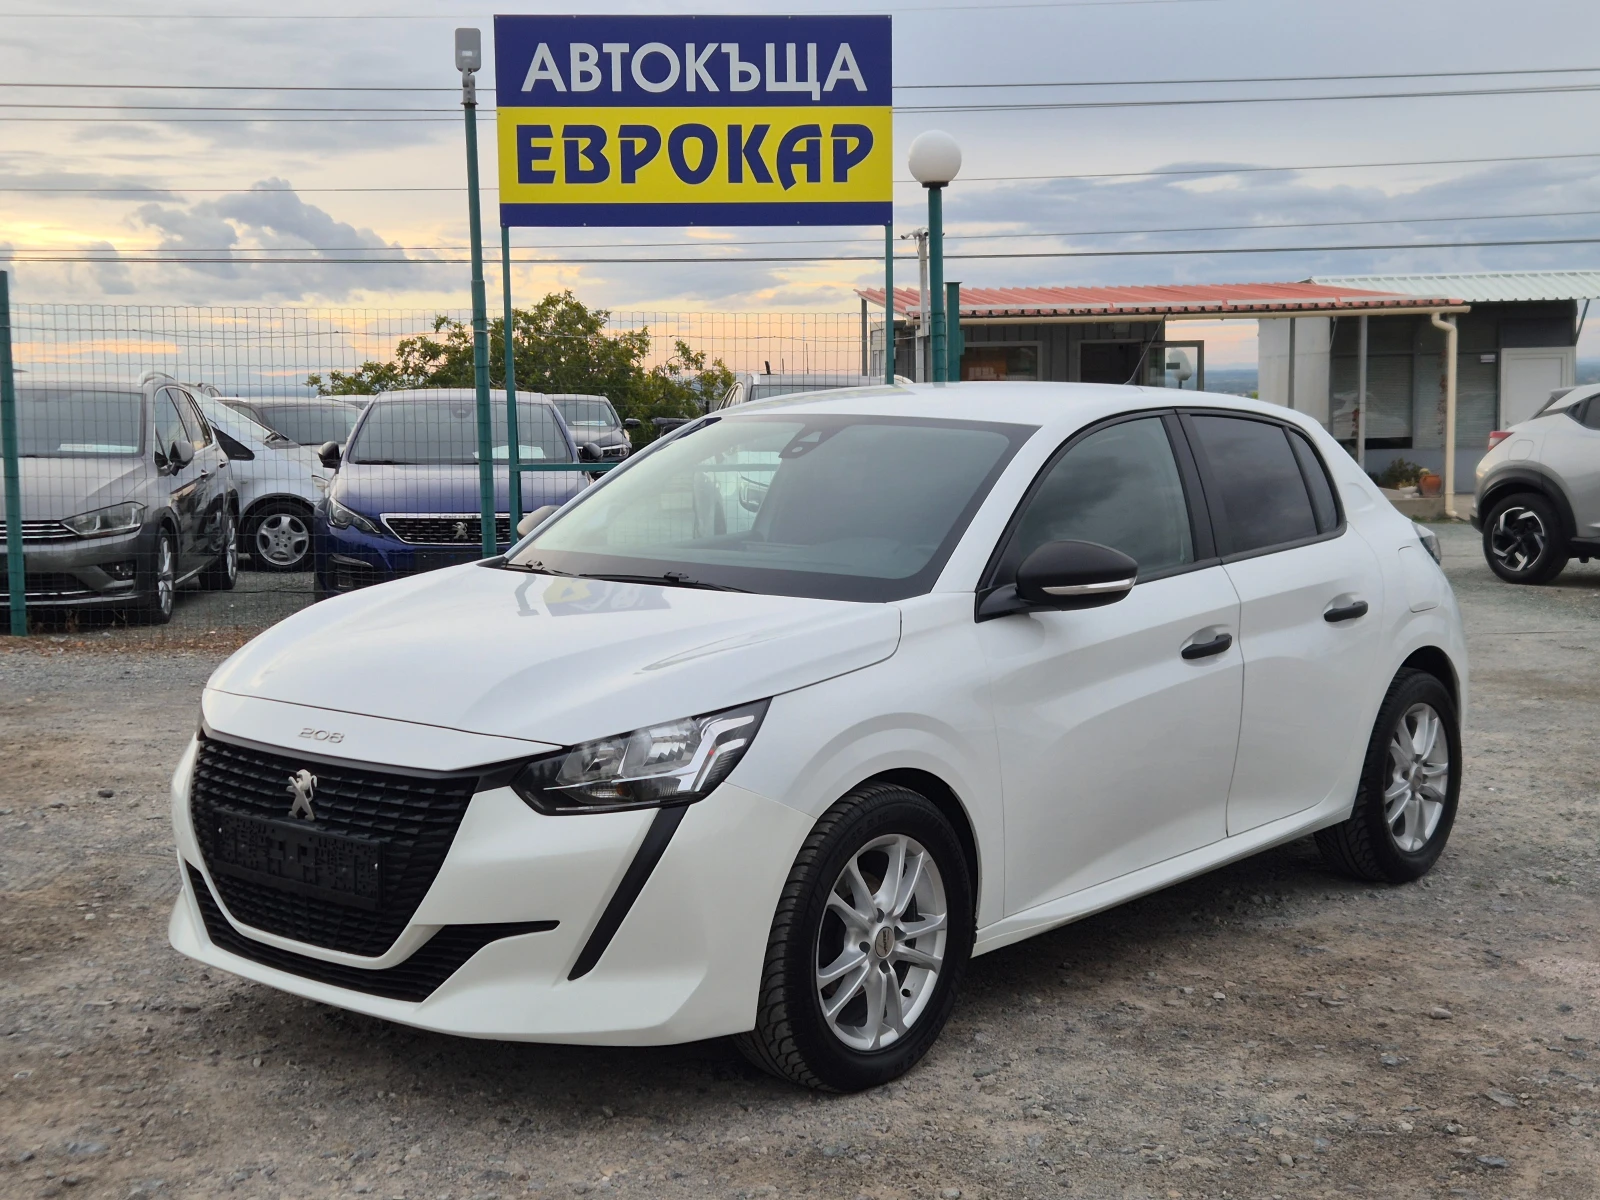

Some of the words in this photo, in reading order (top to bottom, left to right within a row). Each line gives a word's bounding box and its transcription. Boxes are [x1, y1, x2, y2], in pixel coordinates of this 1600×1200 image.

[521, 42, 868, 101] АВТОКЪЩА
[516, 123, 874, 191] ЕВРОКАР
[298, 727, 345, 744] 208
